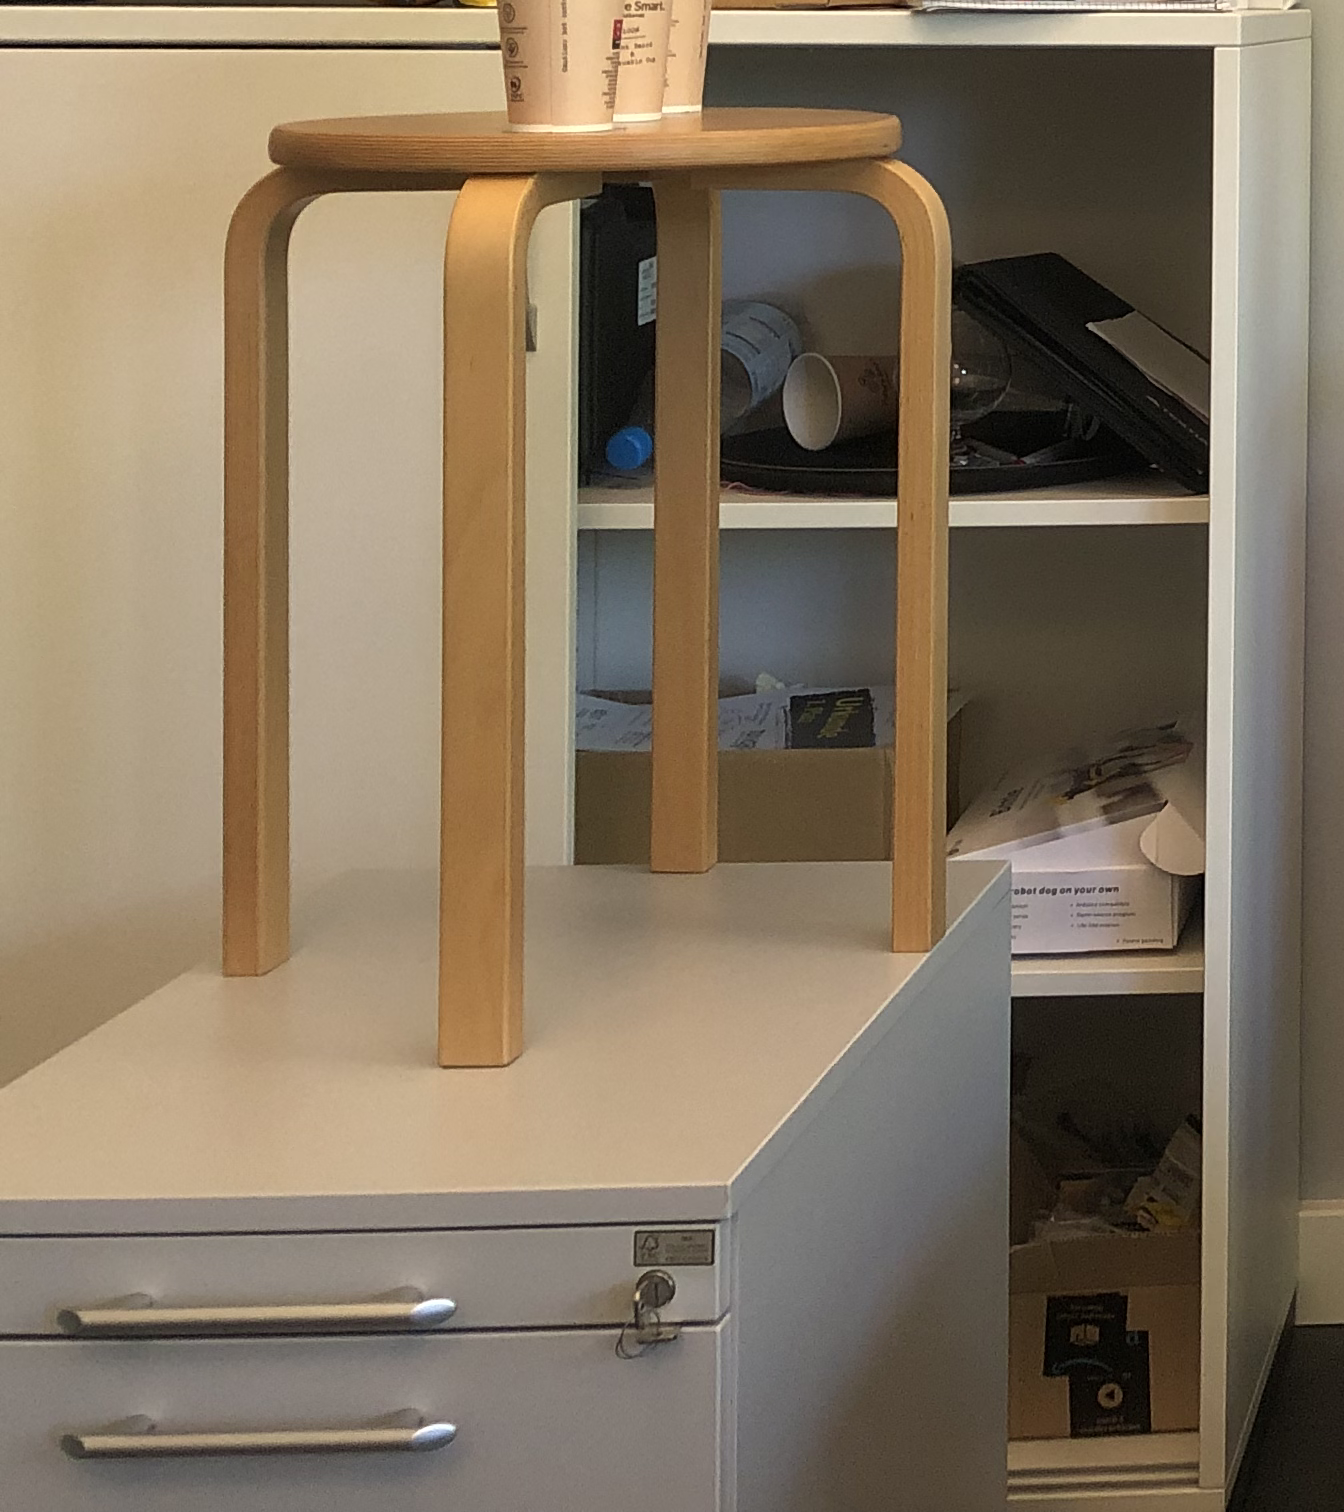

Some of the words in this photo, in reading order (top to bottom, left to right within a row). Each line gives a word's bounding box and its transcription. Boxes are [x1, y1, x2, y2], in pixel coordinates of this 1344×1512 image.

[634, 0, 665, 12] Smart.
[1012, 886, 1037, 896] obot
[1038, 886, 1058, 896] dog
[1059, 887, 1072, 895] on
[1074, 886, 1098, 896] your
[1098, 886, 1120, 894] own
